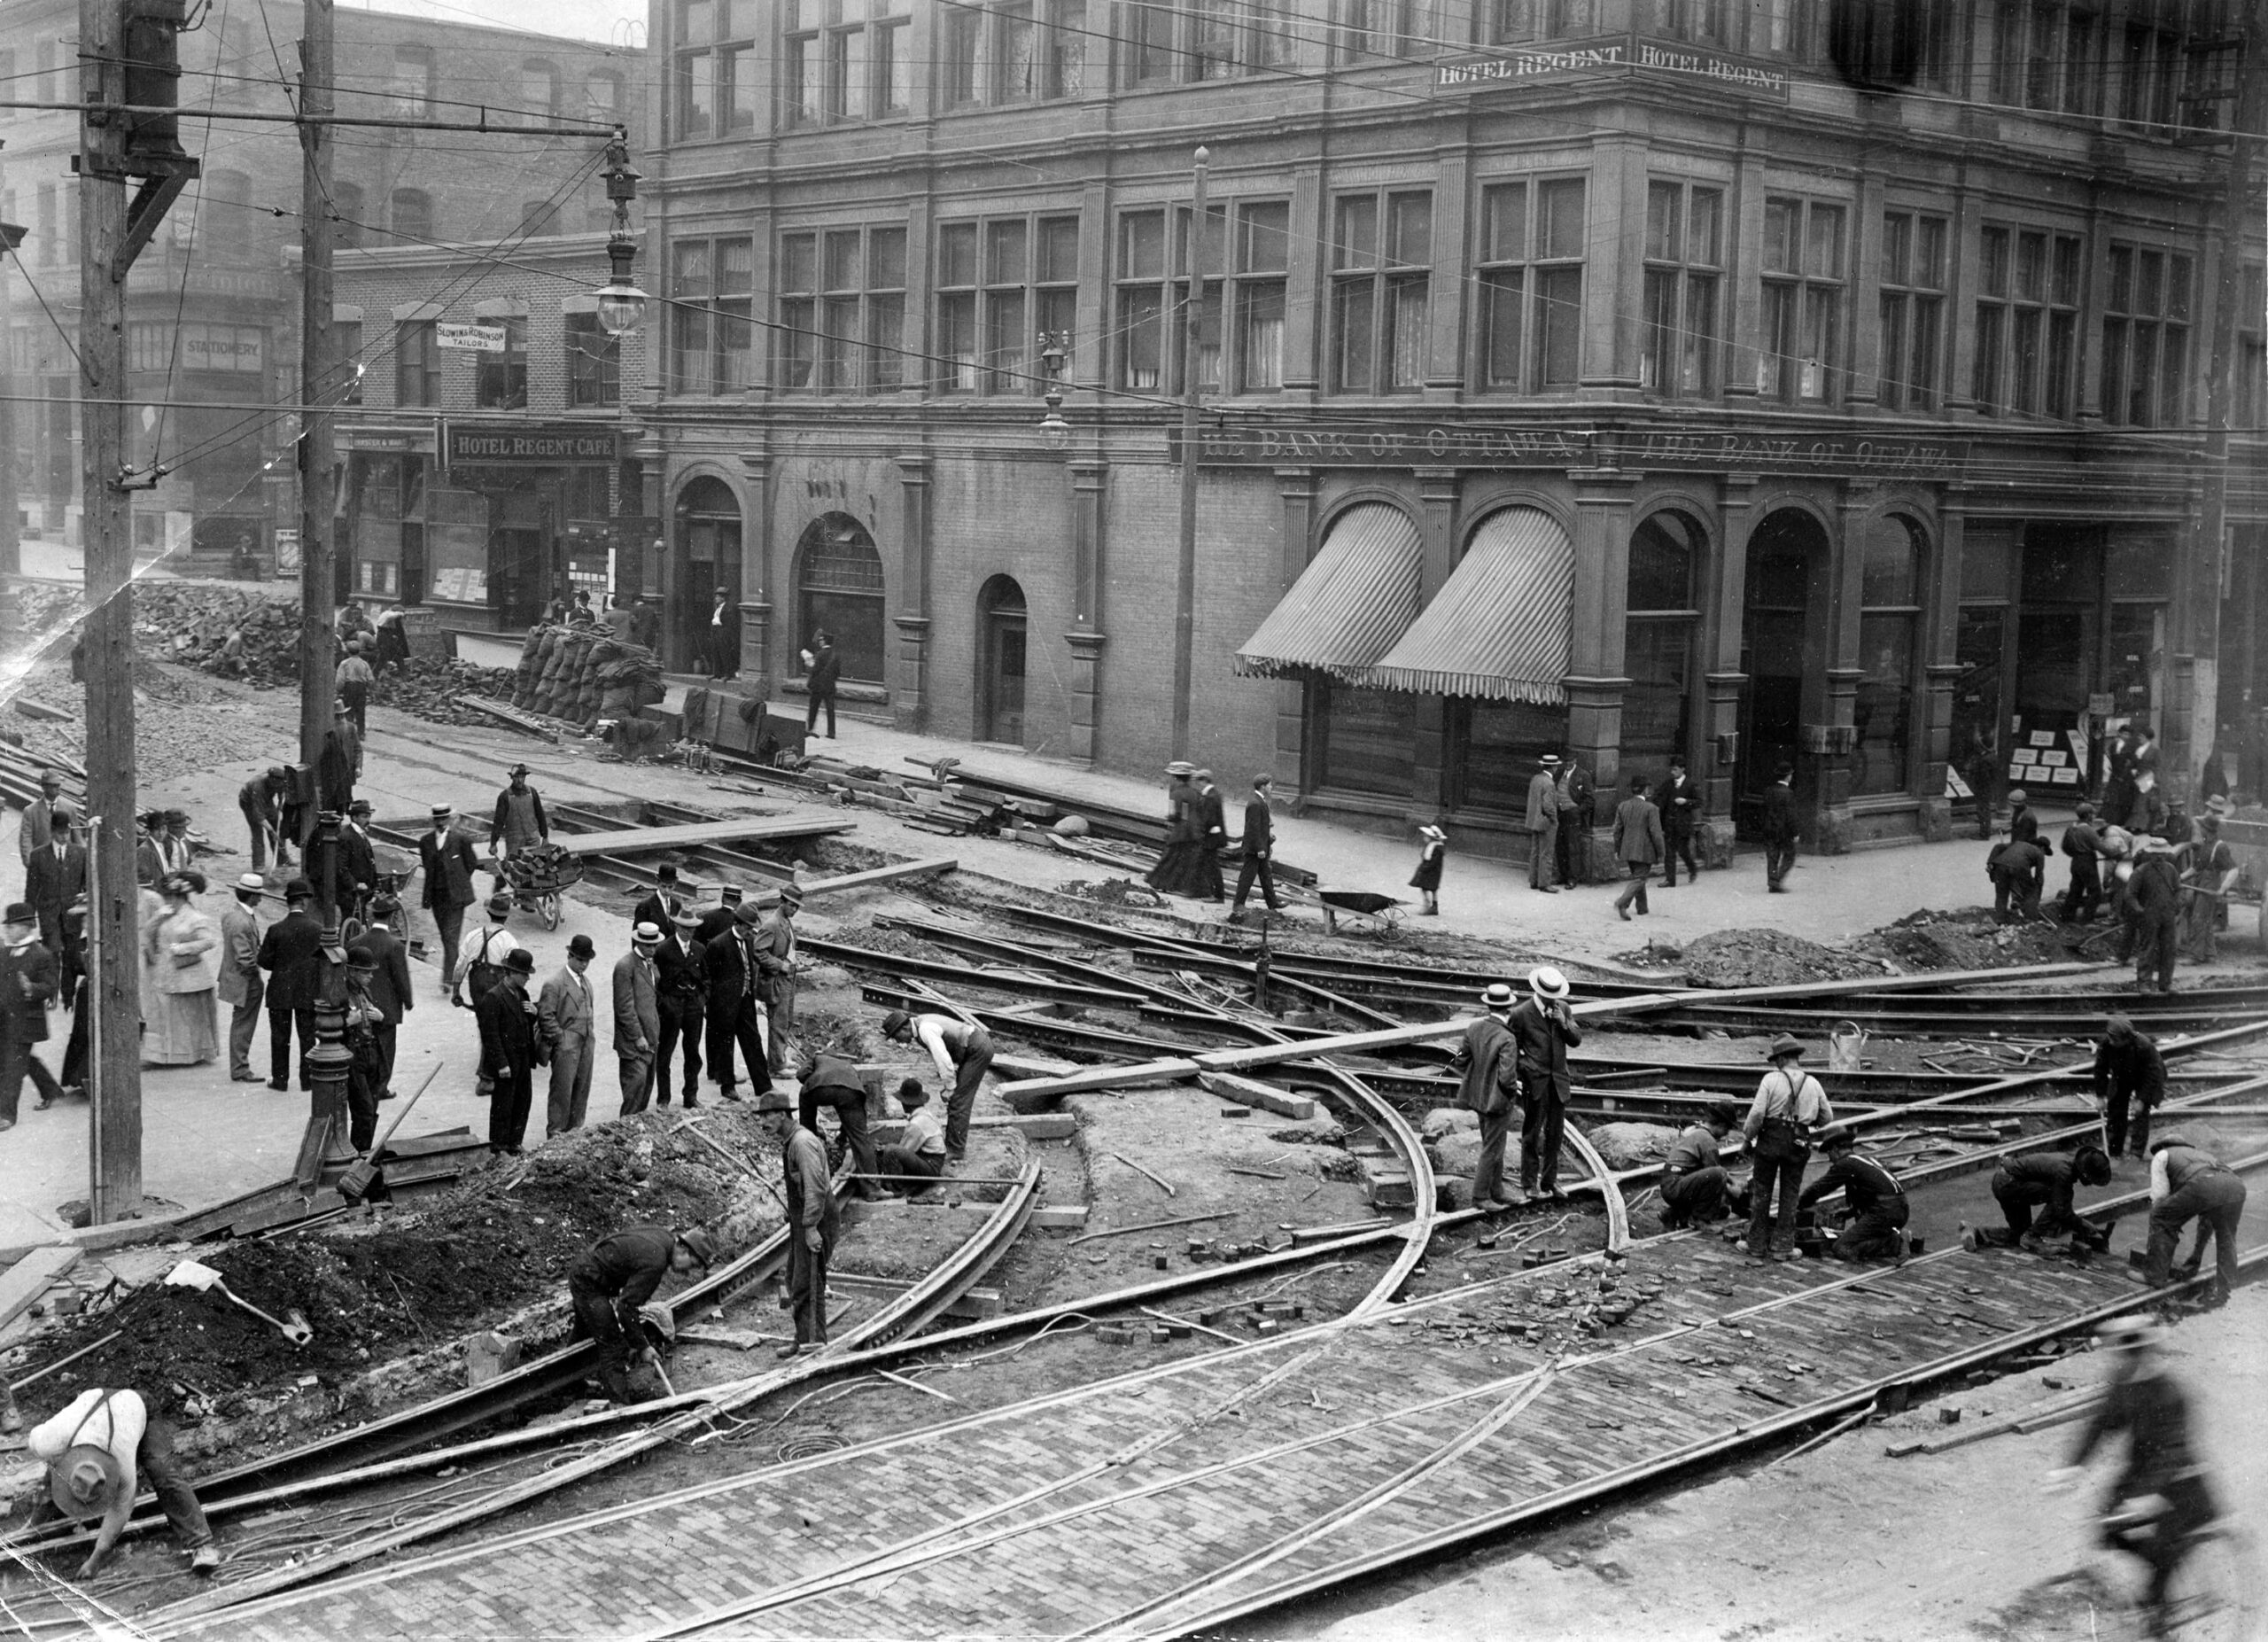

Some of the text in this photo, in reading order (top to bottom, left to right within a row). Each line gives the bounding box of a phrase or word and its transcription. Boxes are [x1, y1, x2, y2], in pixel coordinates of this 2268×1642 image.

[1439, 46, 1622, 85] HOTEL REGENT
[1641, 44, 1784, 90] HOTEL REGENT
[187, 339, 259, 356] STATIONERY
[453, 339, 488, 347] TAILORS
[458, 436, 509, 455] HOTEL
[514, 438, 574, 455] REGENT
[1259, 431, 1353, 456] BANK
[1369, 432, 1407, 457] OF
[1641, 433, 1705, 461] THE
[1715, 434, 1798, 464] BANK
[1810, 442, 1845, 467] OF
